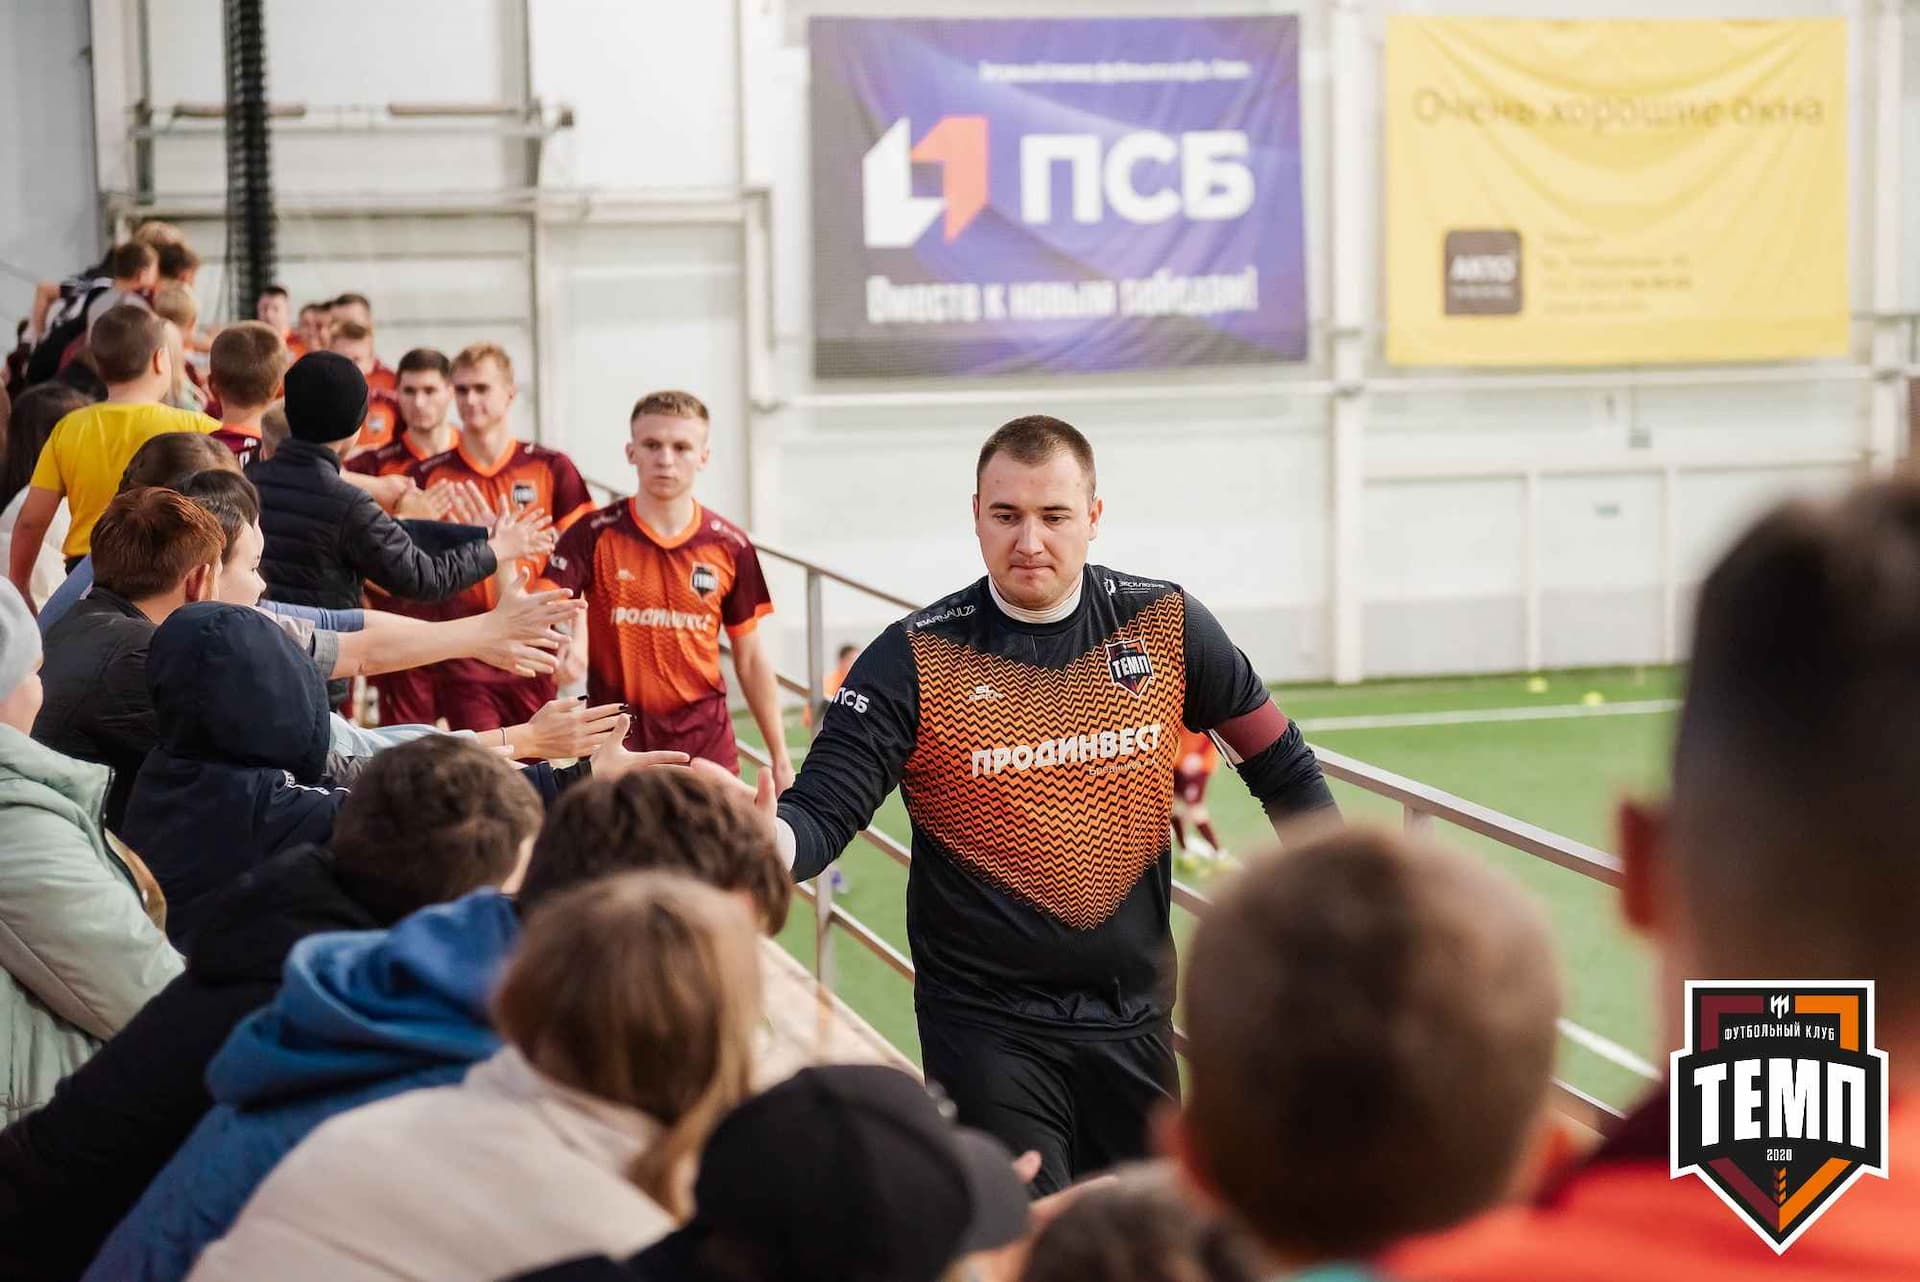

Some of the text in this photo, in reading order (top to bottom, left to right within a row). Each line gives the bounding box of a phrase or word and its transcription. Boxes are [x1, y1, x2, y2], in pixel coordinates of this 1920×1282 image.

[1020, 130, 1255, 224] ПСБ
[1112, 655, 1151, 679] ТЕМП
[971, 723, 1161, 778] ПРОДИНВЕСТ
